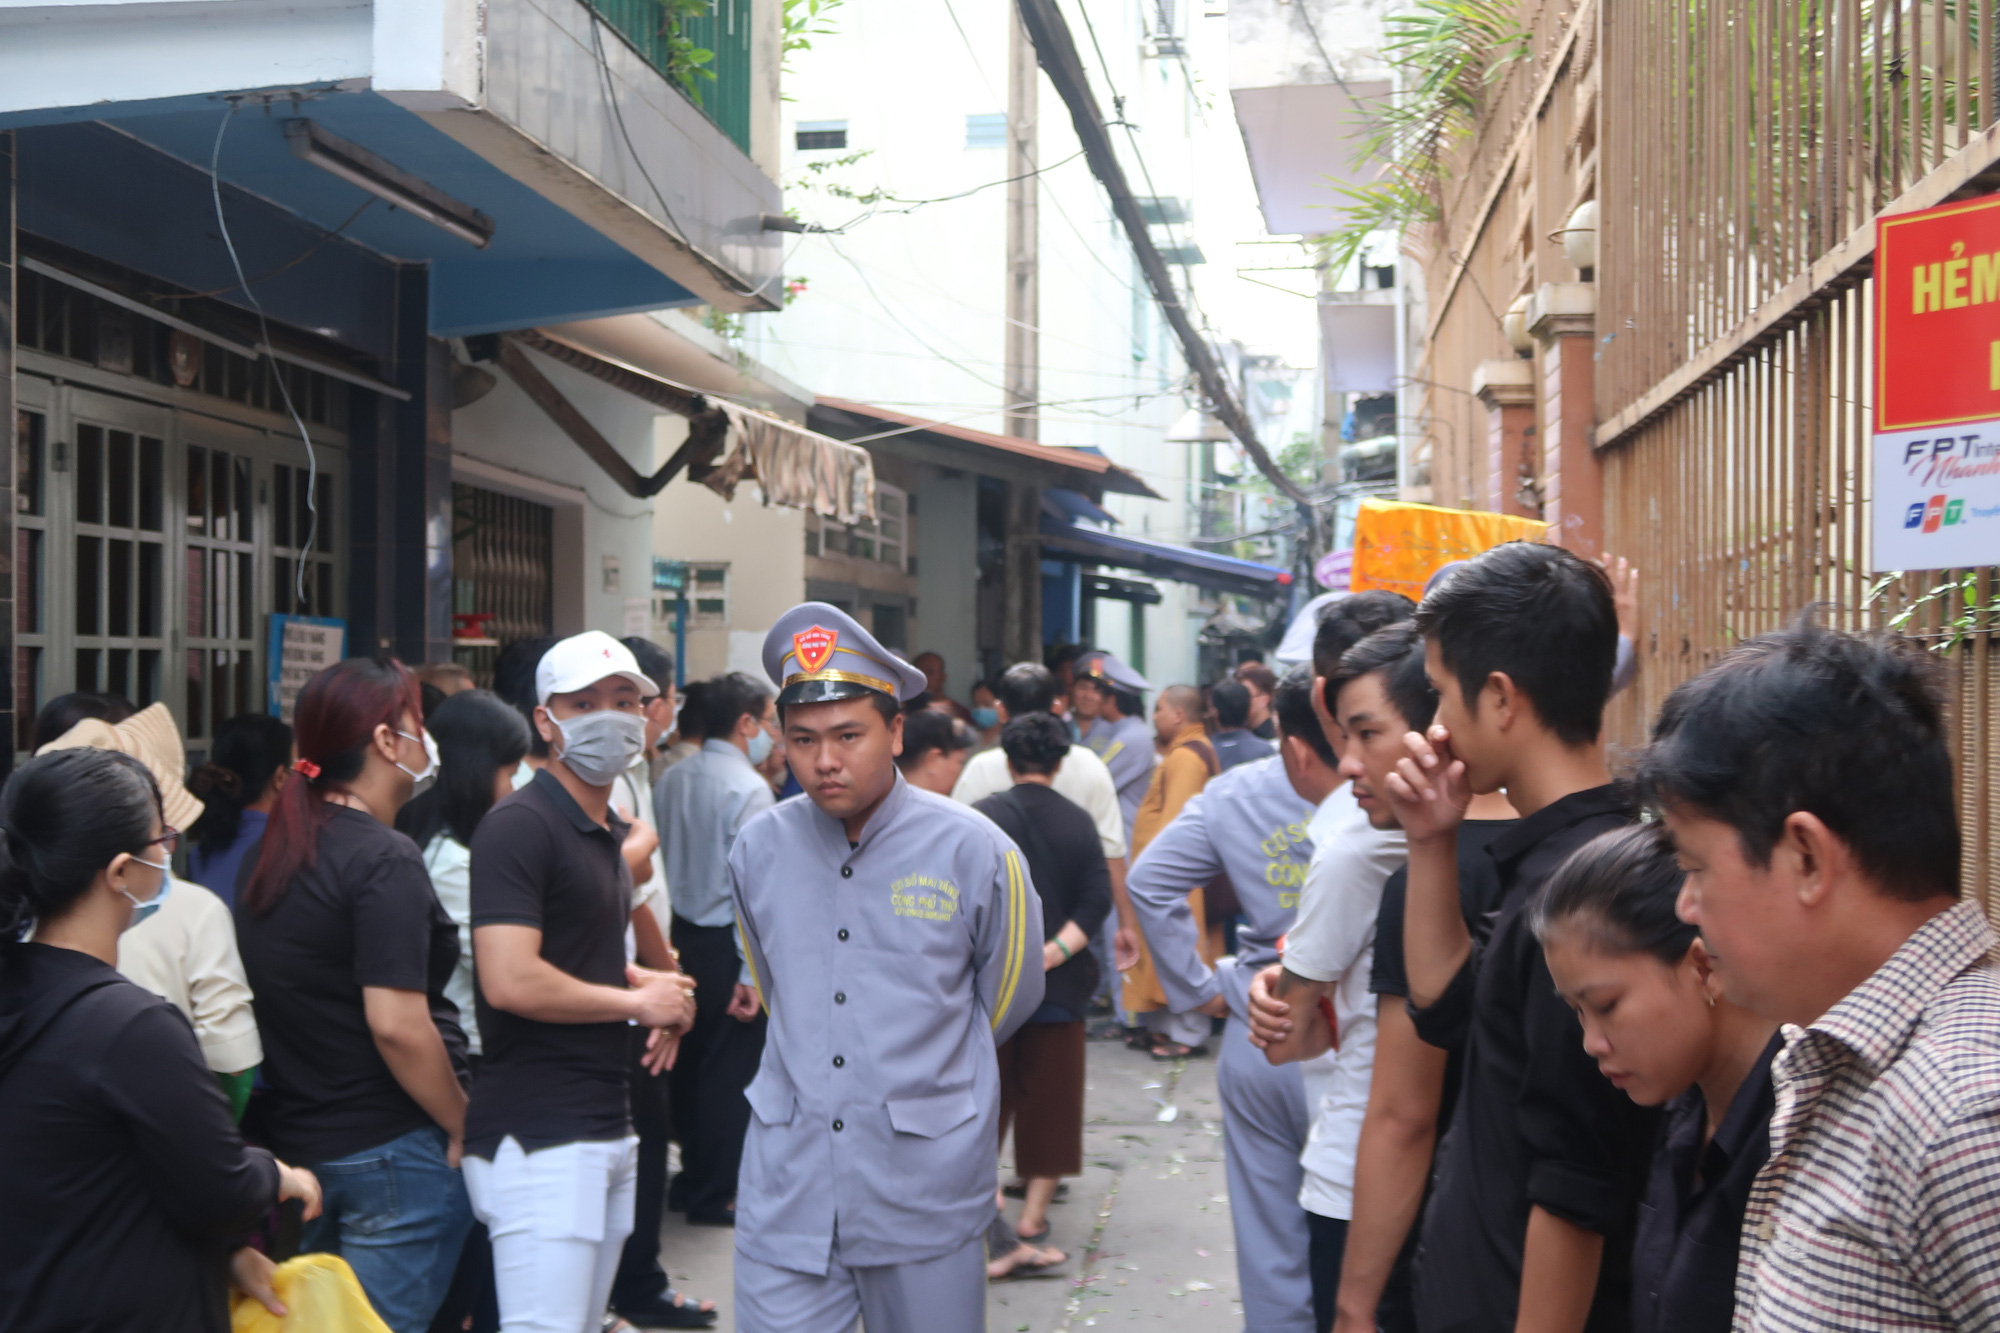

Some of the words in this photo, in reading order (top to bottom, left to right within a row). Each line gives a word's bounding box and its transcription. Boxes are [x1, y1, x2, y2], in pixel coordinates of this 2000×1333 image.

[1904, 434, 1980, 465] FPT
[1903, 494, 1964, 534] FPT
[919, 876, 938, 889] MAI
[1266, 854, 1309, 888] CÔN
[891, 891, 915, 908] CÔNG
